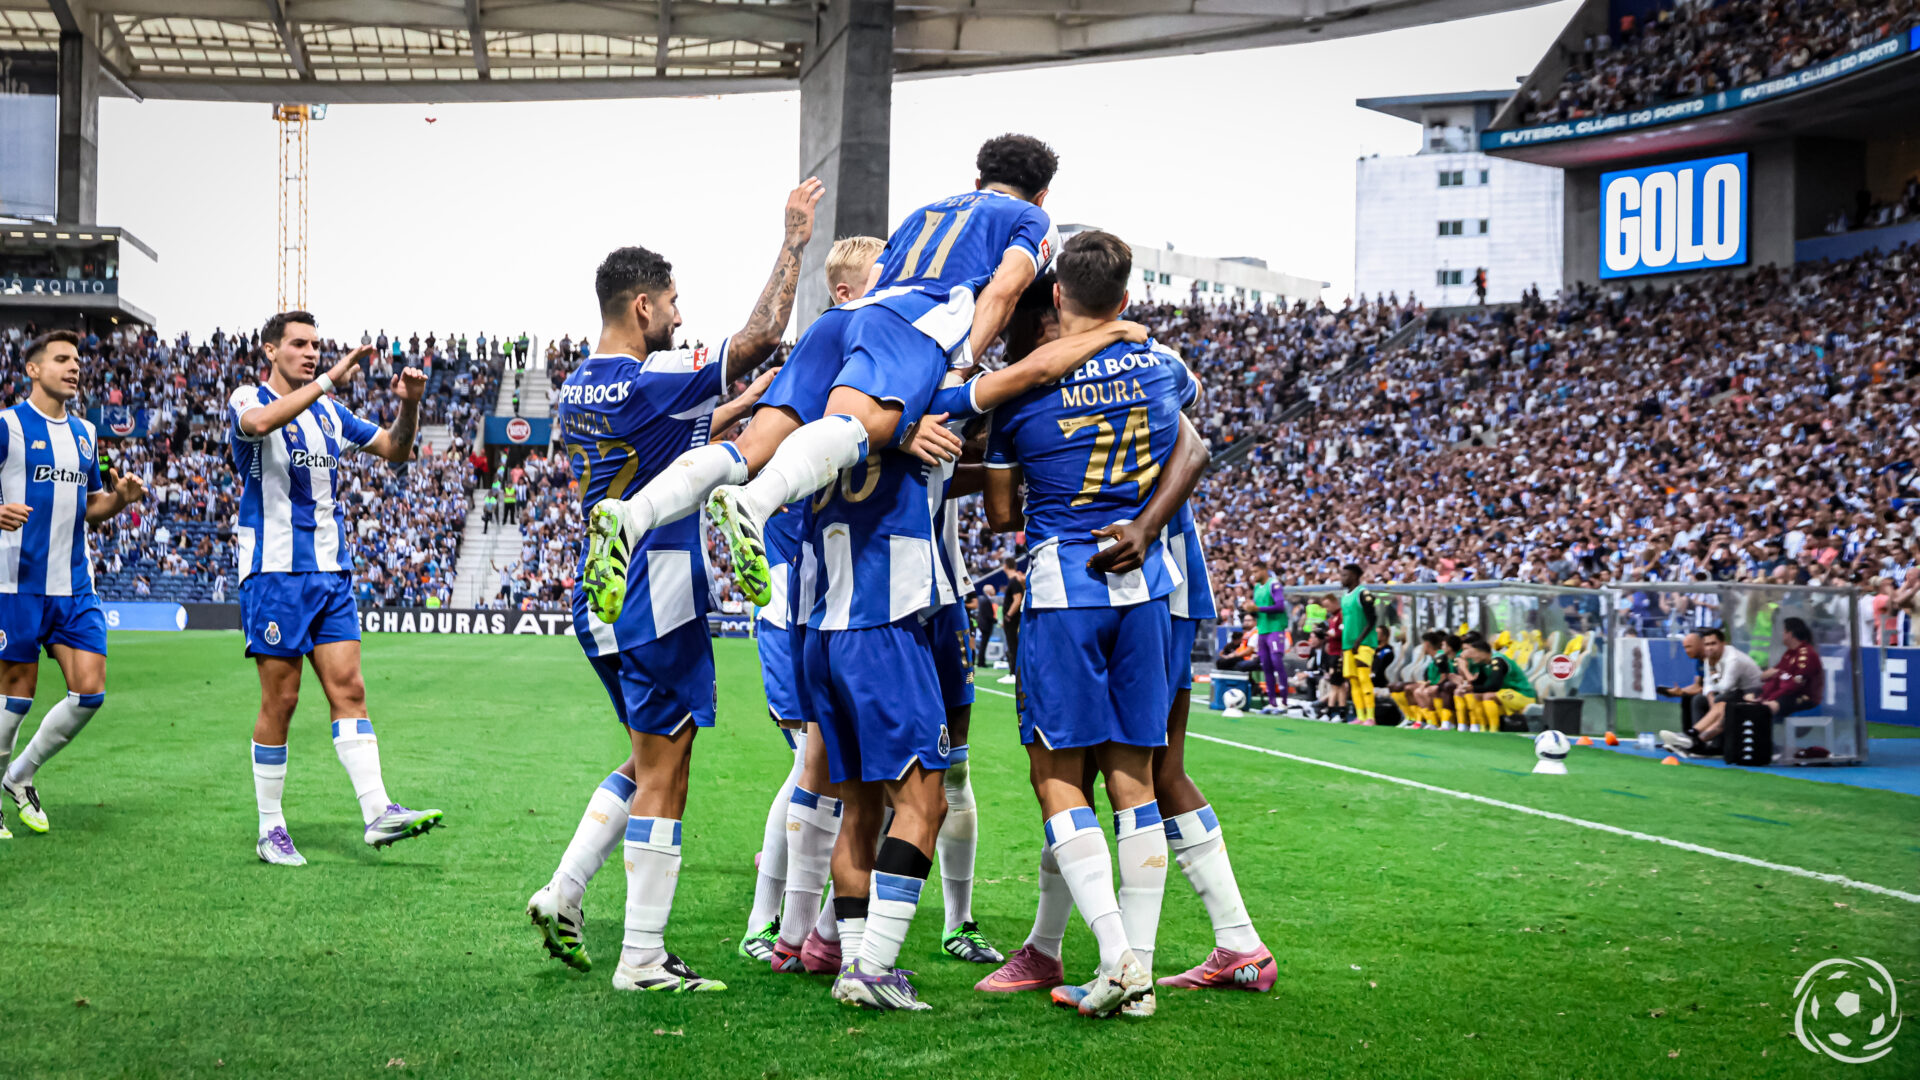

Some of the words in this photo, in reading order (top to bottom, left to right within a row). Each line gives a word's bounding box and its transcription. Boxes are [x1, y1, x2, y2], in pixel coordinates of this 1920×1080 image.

[1500, 123, 1574, 145] FUTEBOL
[1575, 114, 1628, 134] CLUBE
[1629, 109, 1652, 126] DO
[1655, 99, 1705, 120] PORTO
[1605, 163, 1741, 272] GOLO
[895, 209, 974, 282] 11
[584, 381, 632, 405] BOCK
[1060, 377, 1147, 408] MOURA
[33, 465, 88, 486] Betano
[293, 450, 337, 469] Betano
[1056, 406, 1162, 507] 74
